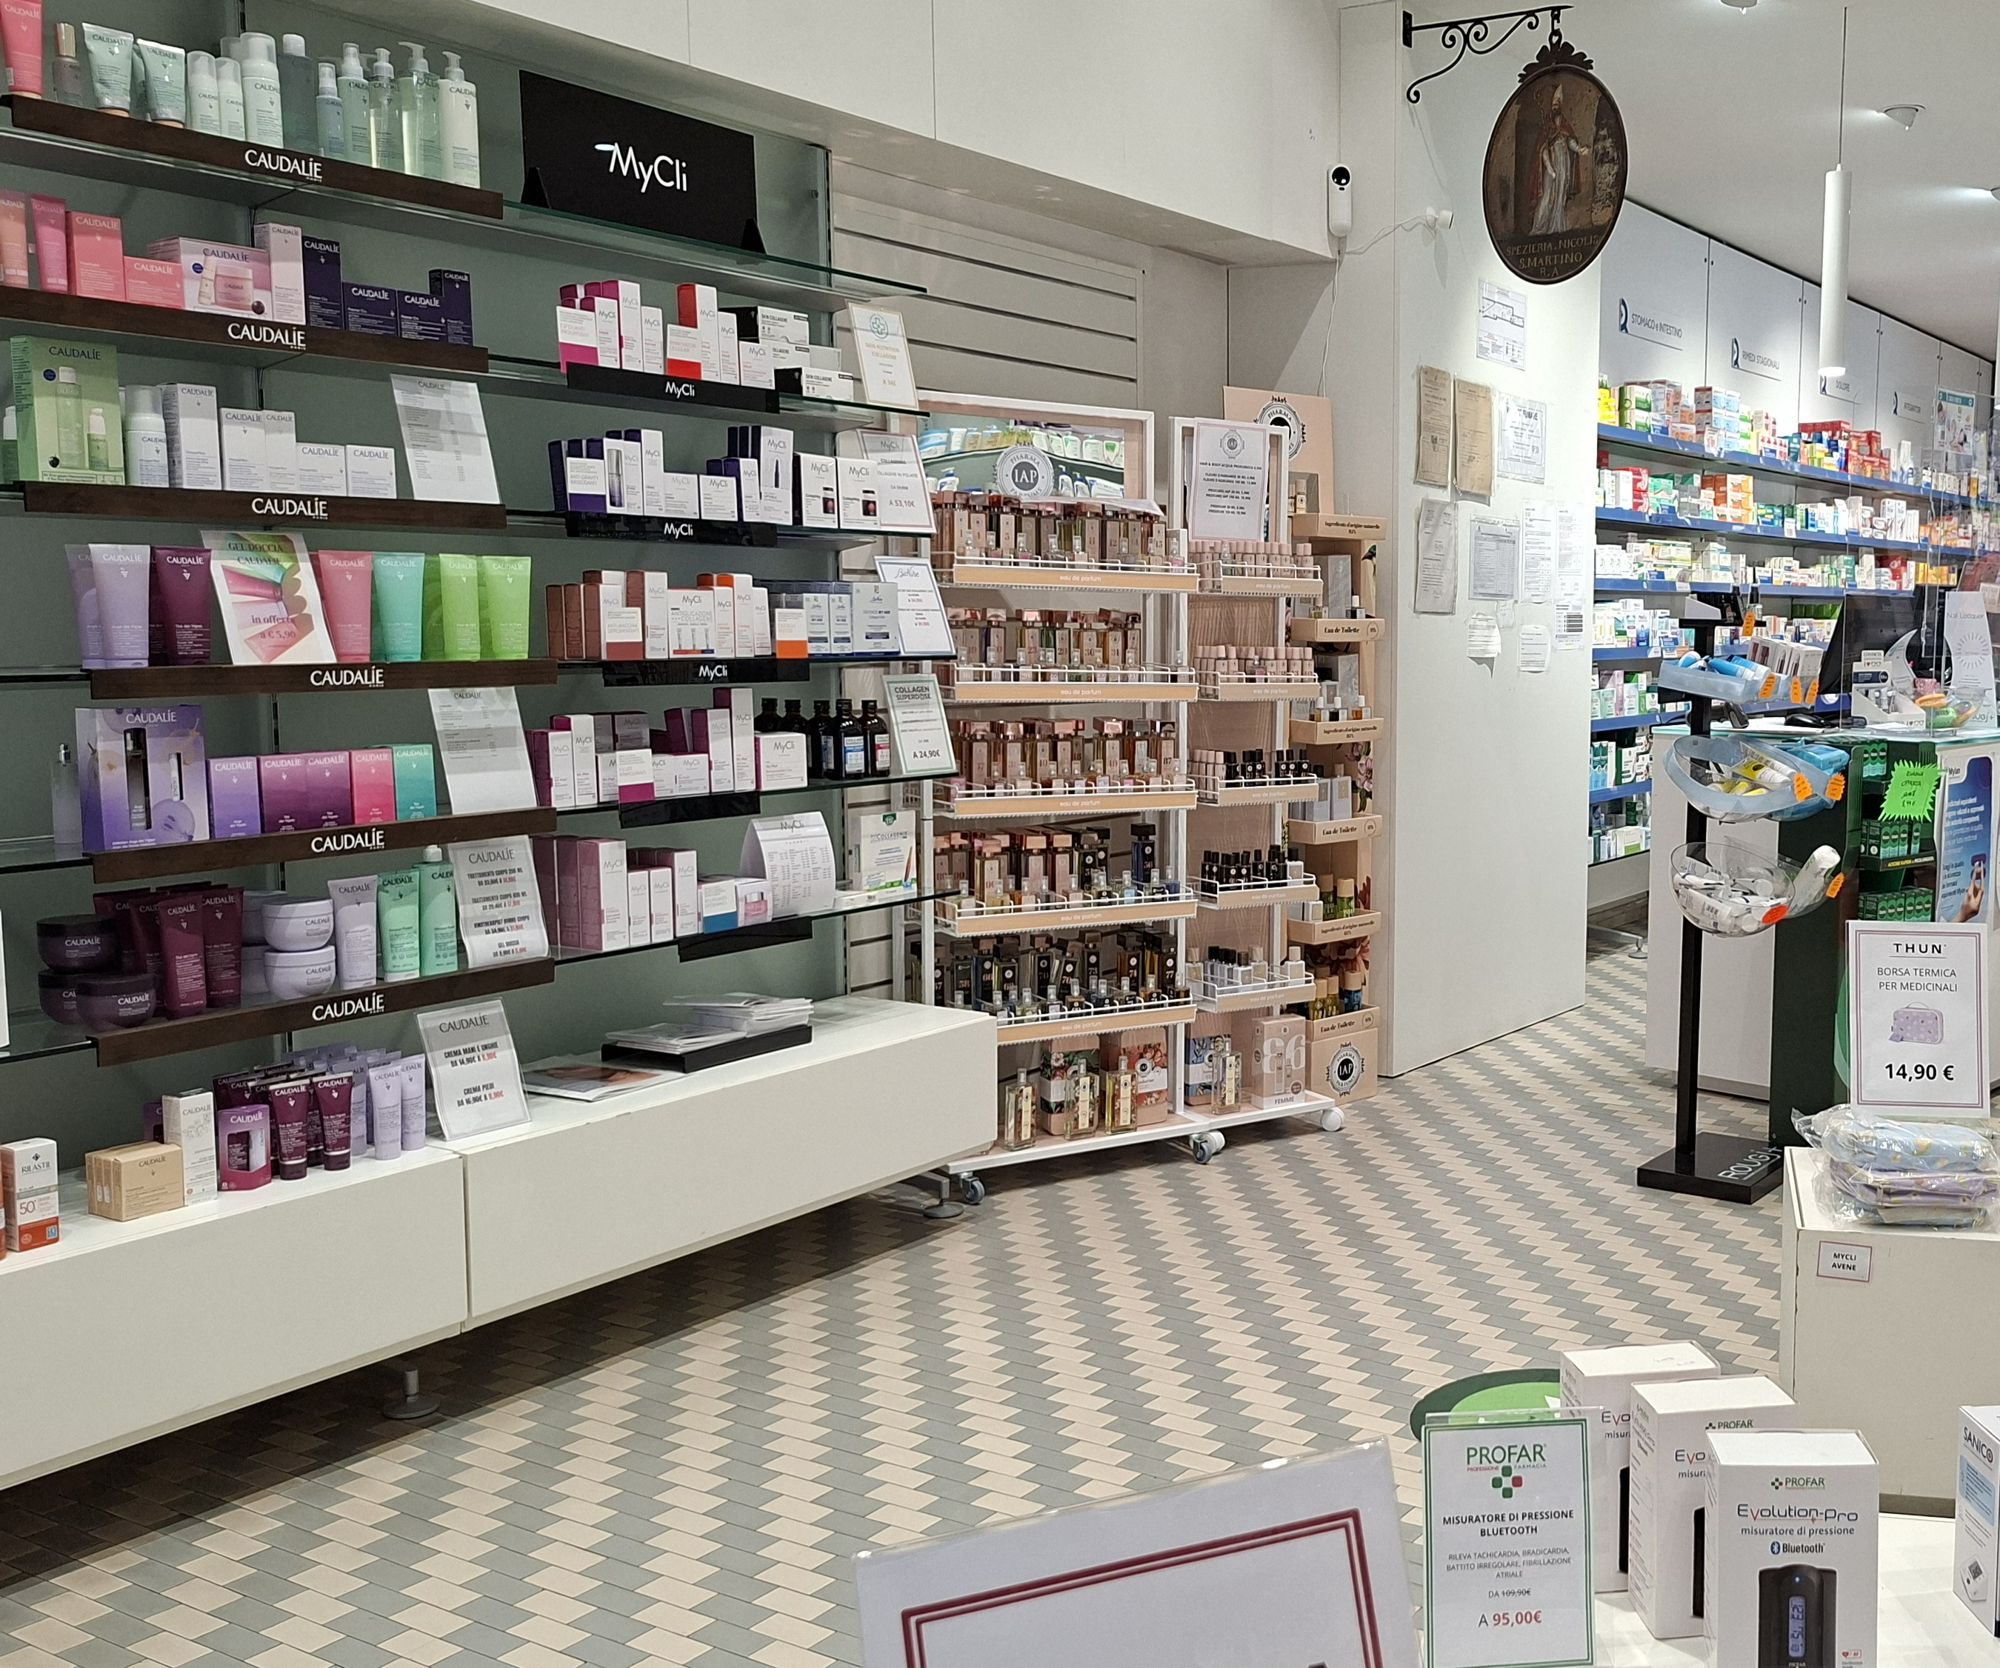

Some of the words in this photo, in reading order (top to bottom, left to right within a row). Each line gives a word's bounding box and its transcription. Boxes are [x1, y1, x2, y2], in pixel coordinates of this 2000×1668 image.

[609, 142, 687, 193] MyCli
[1631, 313, 1655, 329] STOMACO
[1659, 321, 1683, 339] INTESTINO
[665, 381, 695, 398] MyCli
[1014, 468, 1037, 483] IAP
[664, 522, 694, 539] MyCli
[698, 665, 728, 681] MyCli
[1893, 943, 1942, 954] THUN
[1877, 967, 1911, 977] BORSA
[1913, 968, 1957, 978] TERMICA
[1879, 982, 1897, 990] PER
[1900, 982, 1958, 992] MEDICINALI
[1885, 1063, 1937, 1082] 14,90
[1943, 1064, 1955, 1080] €
[1833, 1252, 1857, 1261] MYCLI
[1831, 1262, 1857, 1271] AVENE
[1717, 1419, 1754, 1429] PROFAR
[1963, 1426, 1994, 1464] SANICO
[1466, 1443, 1546, 1465] PROFAR
[1785, 1477, 1825, 1487] PROFAR
[1443, 1512, 1506, 1525] MISURATORE
[1509, 1512, 1519, 1522] DI
[1521, 1510, 1574, 1522] PRESSIONE
[1480, 1525, 1538, 1537] BLUETOOTH
[1741, 1526, 1795, 1536] misuratore
[1797, 1526, 1806, 1536] di
[1808, 1526, 1855, 1539] pressione
[1782, 1542, 1824, 1554] Bluetooth
[1448, 1552, 1472, 1560] RILEVA
[1446, 1563, 1476, 1571] BATTITO
[1477, 1561, 1521, 1570] IRREGOLARE,
[1522, 1557, 1571, 1567] FIBRILLAZIONE
[1496, 1570, 1523, 1579] ATRIALE
[1488, 1589, 1500, 1598] DA
[1478, 1614, 1488, 1627] A
[1492, 1610, 1542, 1628] 95,00€
